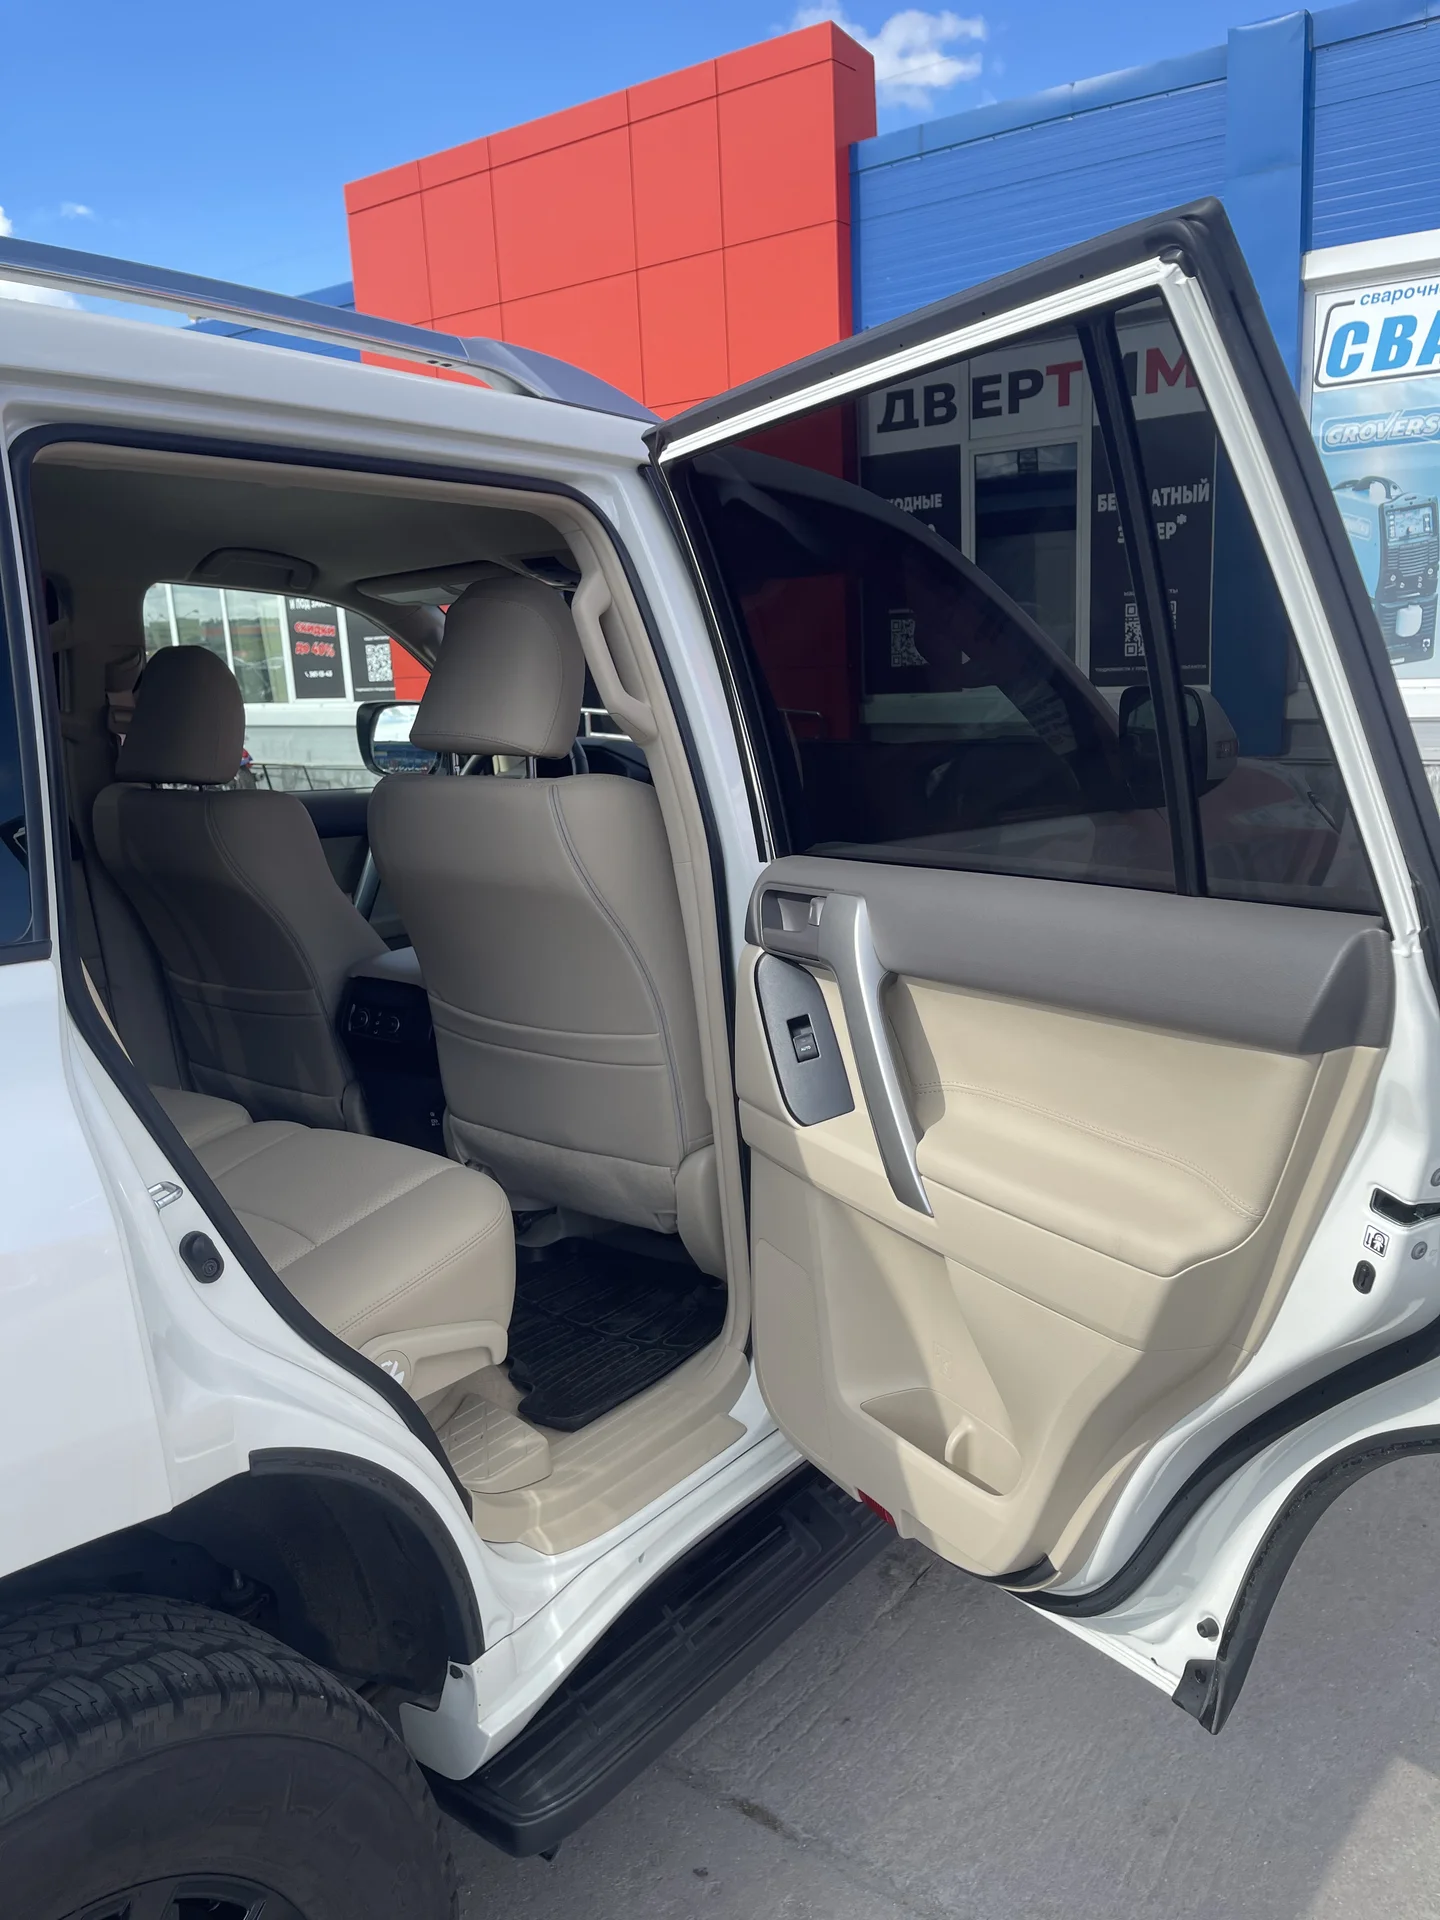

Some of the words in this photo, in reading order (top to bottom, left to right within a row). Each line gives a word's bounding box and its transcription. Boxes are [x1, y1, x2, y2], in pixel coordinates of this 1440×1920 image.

[1360, 283, 1440, 305] сварочн
[1325, 409, 1440, 446] GROVERS
[886, 493, 943, 513] ОДНЫЕ
[1097, 478, 1210, 512] БЕАТНЫЙ
